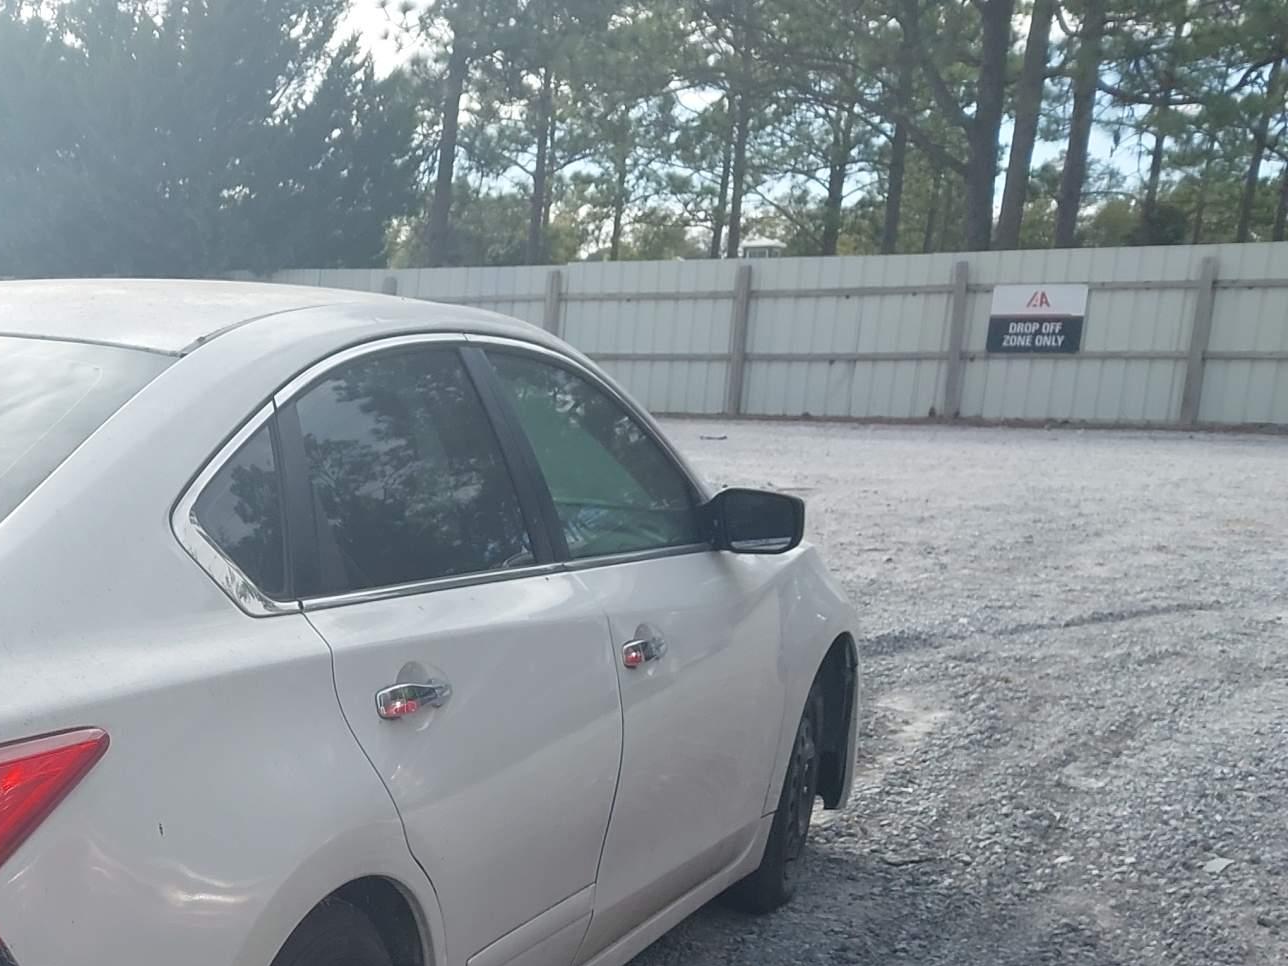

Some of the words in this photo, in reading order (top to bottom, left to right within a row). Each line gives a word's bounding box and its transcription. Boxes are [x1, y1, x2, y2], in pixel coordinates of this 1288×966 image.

[1008, 322, 1039, 333] DROP
[1042, 322, 1063, 333] OFF
[1002, 335, 1033, 346] ZONE
[1035, 335, 1065, 347] ONLY
